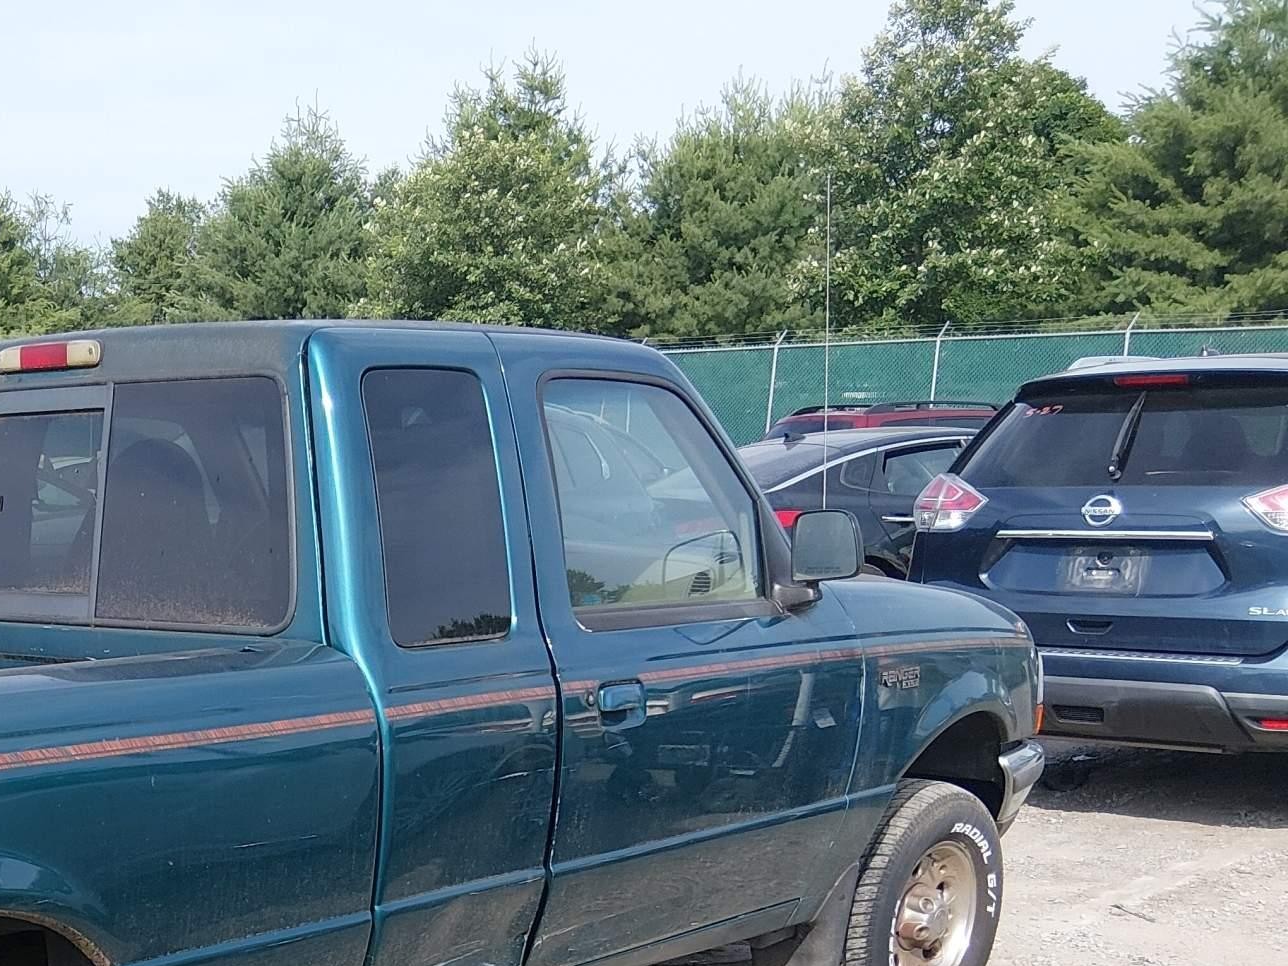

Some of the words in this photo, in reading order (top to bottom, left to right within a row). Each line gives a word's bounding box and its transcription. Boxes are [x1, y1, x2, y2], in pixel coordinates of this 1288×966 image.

[1083, 507, 1116, 515] NISSAN
[1247, 606, 1273, 615] SL
[950, 822, 993, 865] RADIAL
[986, 873, 997, 918] G/T
